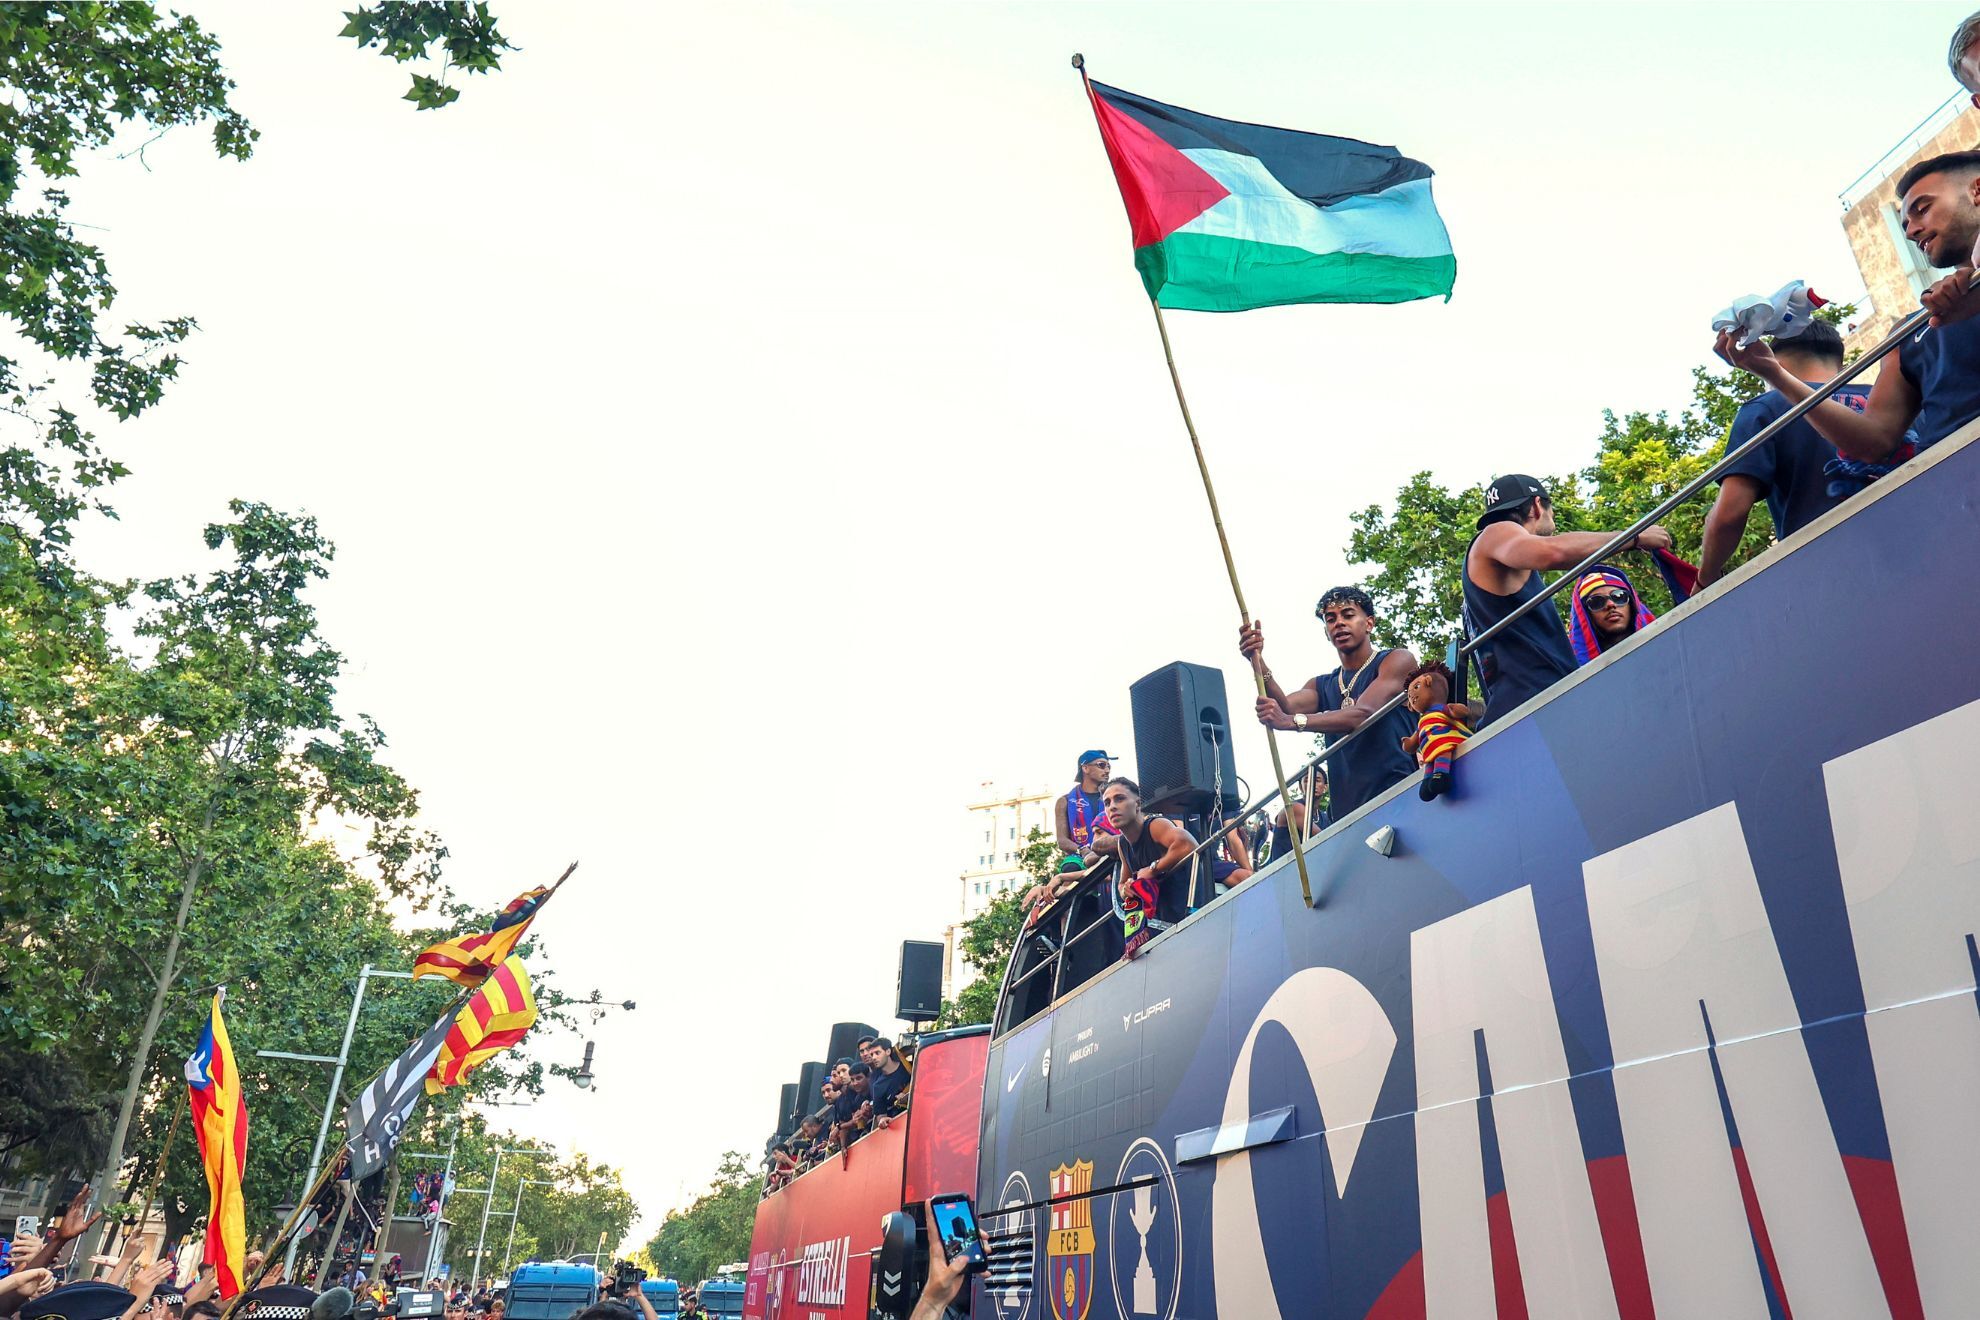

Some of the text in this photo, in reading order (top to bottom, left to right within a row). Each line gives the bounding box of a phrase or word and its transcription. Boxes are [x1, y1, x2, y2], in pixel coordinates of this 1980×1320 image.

[1134, 997, 1171, 1024] CUPRA
[1060, 1231, 1079, 1253] FCB
[798, 1235, 850, 1305] ESTRELLA
